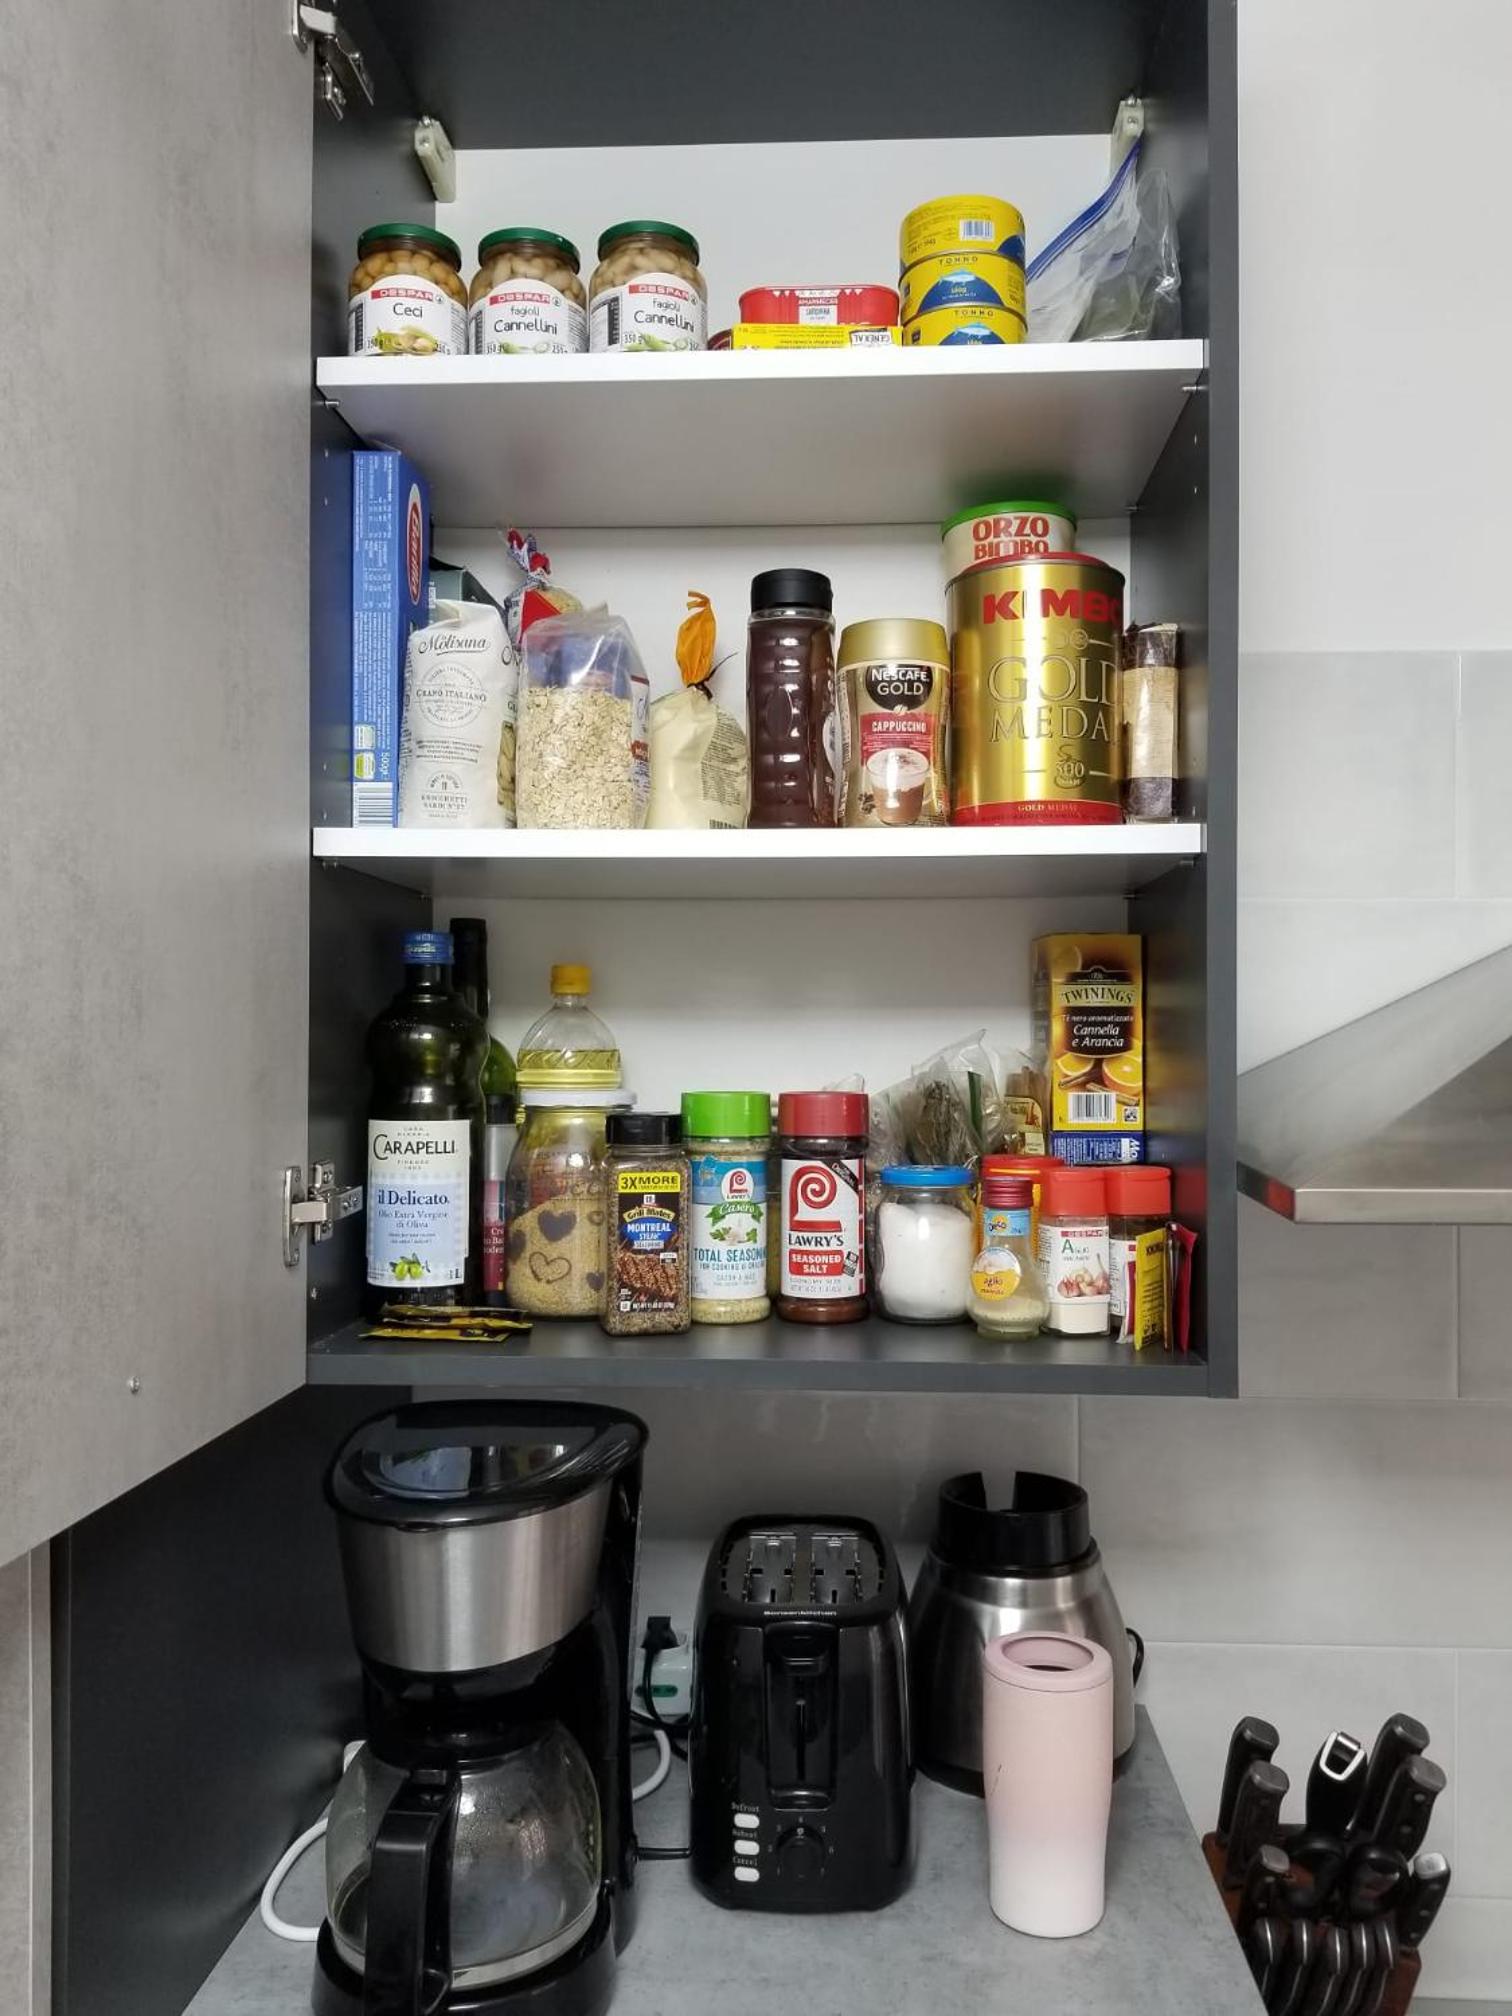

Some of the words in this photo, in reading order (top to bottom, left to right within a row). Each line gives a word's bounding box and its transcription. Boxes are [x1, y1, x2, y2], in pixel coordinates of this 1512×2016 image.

[940, 256, 978, 266] TONNO
[380, 288, 433, 302] DESPAR
[638, 284, 689, 301] DESPAR
[393, 302, 423, 318] Ceci
[954, 309, 995, 317] TONNO
[494, 319, 558, 335] Cannellini
[633, 309, 695, 333] Cannellini
[972, 515, 1049, 542] ORZO
[416, 689, 443, 698] GRANO
[445, 690, 487, 702] ITALIANO
[877, 682, 924, 696] GOLD
[871, 720, 927, 733] CAPPUCCINO
[1018, 803, 1045, 812] GOLD
[1062, 986, 1134, 1004] TWININGS
[1073, 1024, 1120, 1036] Cannella
[1071, 1038, 1079, 1048] e
[1081, 1036, 1125, 1047] Arancia
[373, 1133, 456, 1161] CARAPELLI
[620, 1176, 638, 1191] 3X
[638, 1175, 679, 1185] MORE
[378, 1189, 385, 1205] il
[387, 1189, 449, 1206] Delicato
[627, 1222, 673, 1233] MONTREAL
[788, 1232, 845, 1247] LAWRY'S
[693, 1247, 722, 1262] TOTAL
[791, 1253, 842, 1264] SEASONED
[803, 1264, 828, 1274] SALT
[732, 1855, 758, 1867] Cancel
